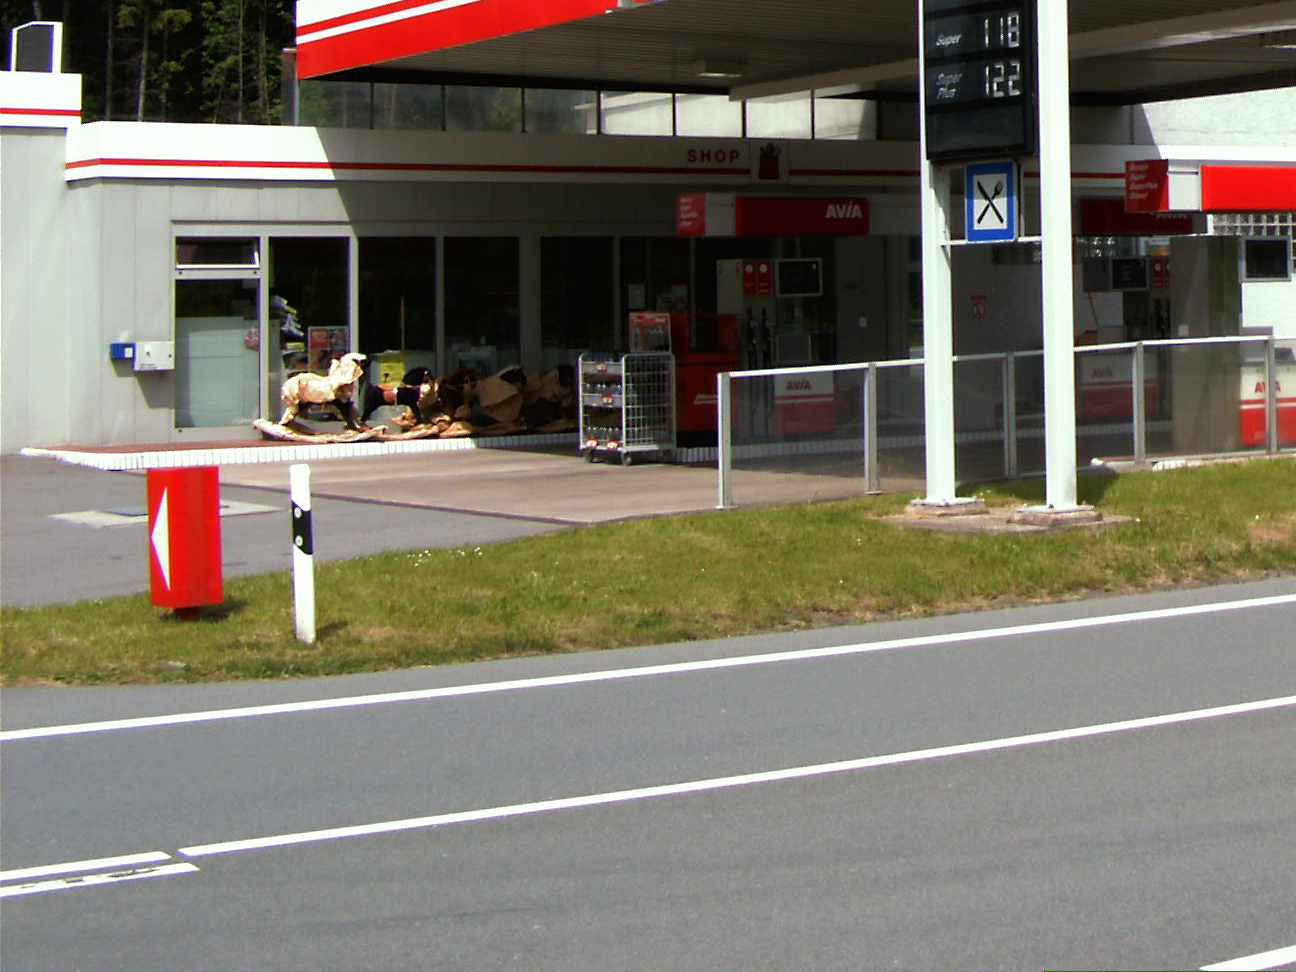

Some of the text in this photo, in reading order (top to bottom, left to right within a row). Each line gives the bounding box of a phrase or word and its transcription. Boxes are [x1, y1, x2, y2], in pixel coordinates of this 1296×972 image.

[984, 12, 1020, 48] 118
[985, 61, 1020, 98] 122
[687, 149, 740, 163] SHOP
[825, 201, 863, 219] AVIA
[786, 378, 812, 391] AVIA
